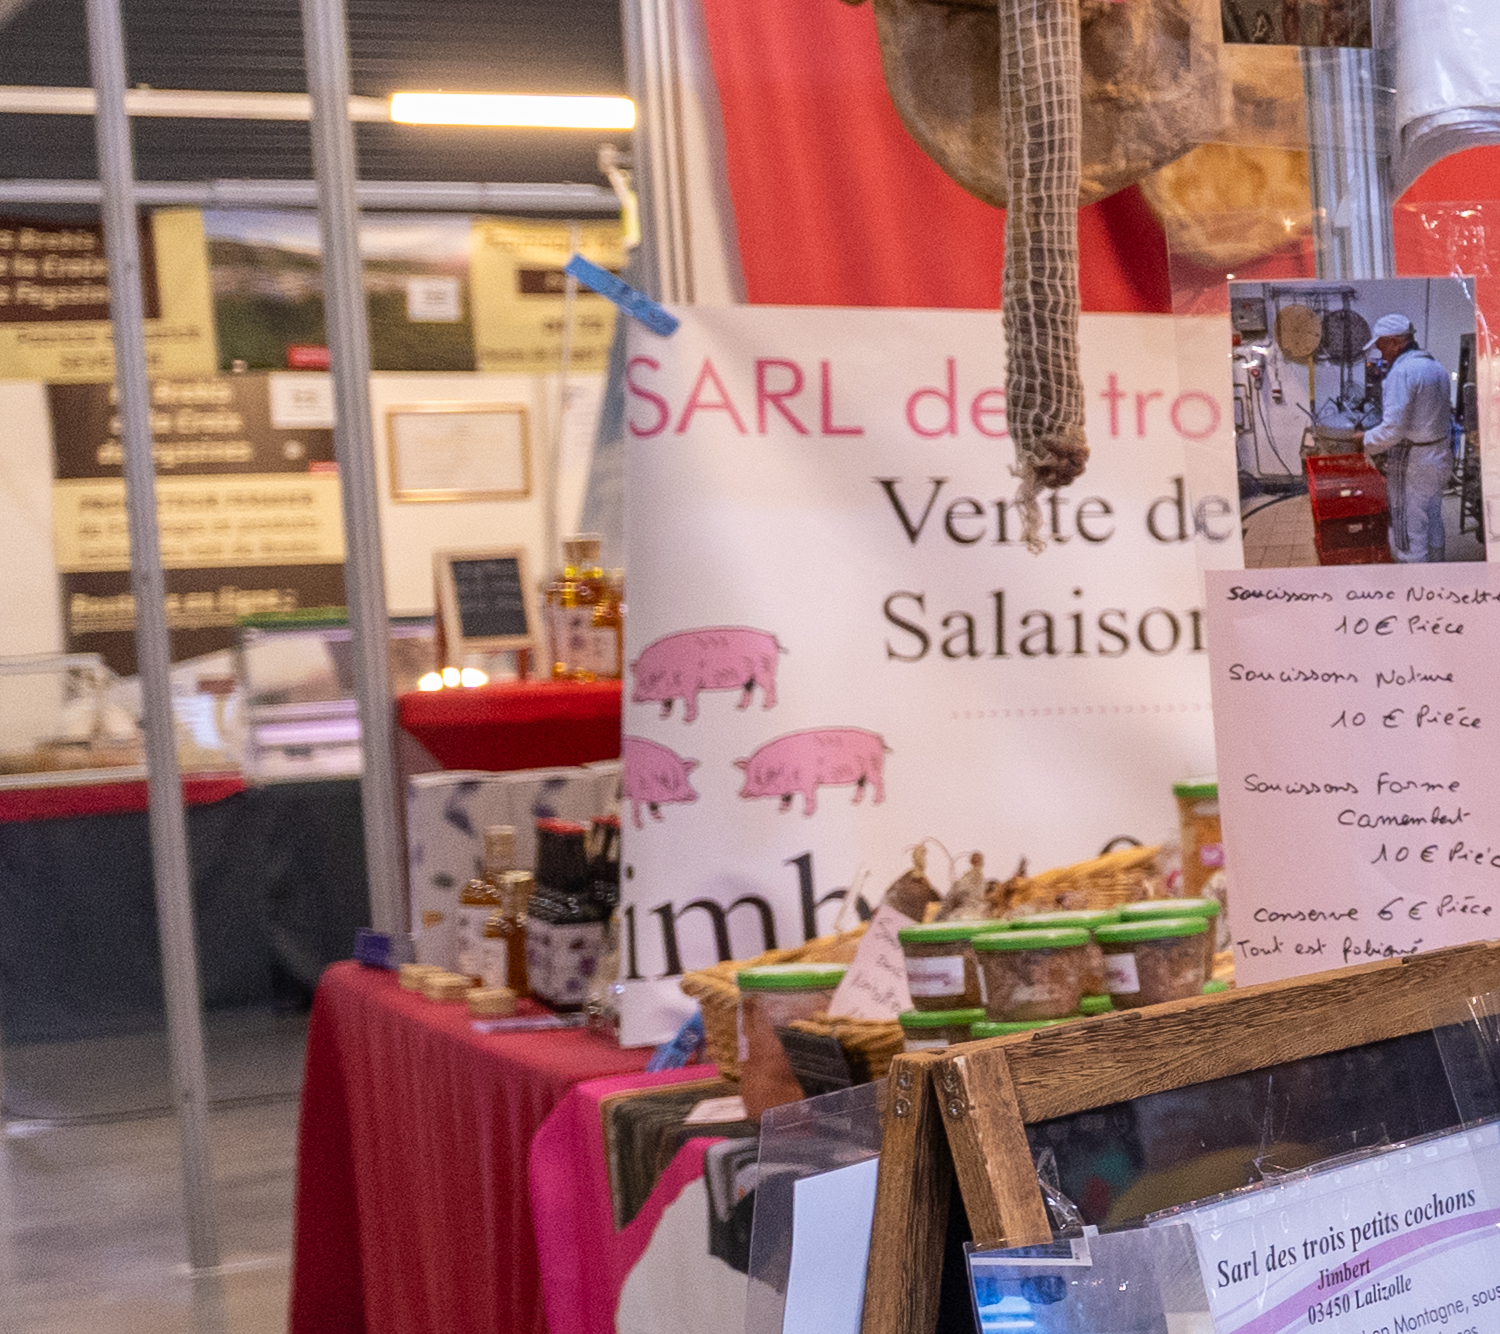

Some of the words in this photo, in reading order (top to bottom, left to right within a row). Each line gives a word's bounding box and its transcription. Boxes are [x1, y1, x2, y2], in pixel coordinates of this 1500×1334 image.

[627, 356, 863, 440] SARL
[905, 357, 1009, 440] de
[1100, 371, 1222, 441] tro
[872, 478, 1114, 546] Vente
[1146, 476, 1234, 544] de
[1295, 941, 1327, 956] est
[1217, 1250, 1259, 1288] Sarl
[1265, 1244, 1296, 1272] des
[1302, 1226, 1345, 1260] trois
[1349, 1210, 1398, 1248] petits
[1404, 1189, 1475, 1227] cochons
[1307, 1293, 1350, 1324] 03450
[1353, 1274, 1411, 1309] Lalizolle
[1317, 1258, 1370, 1290] Jimbert
